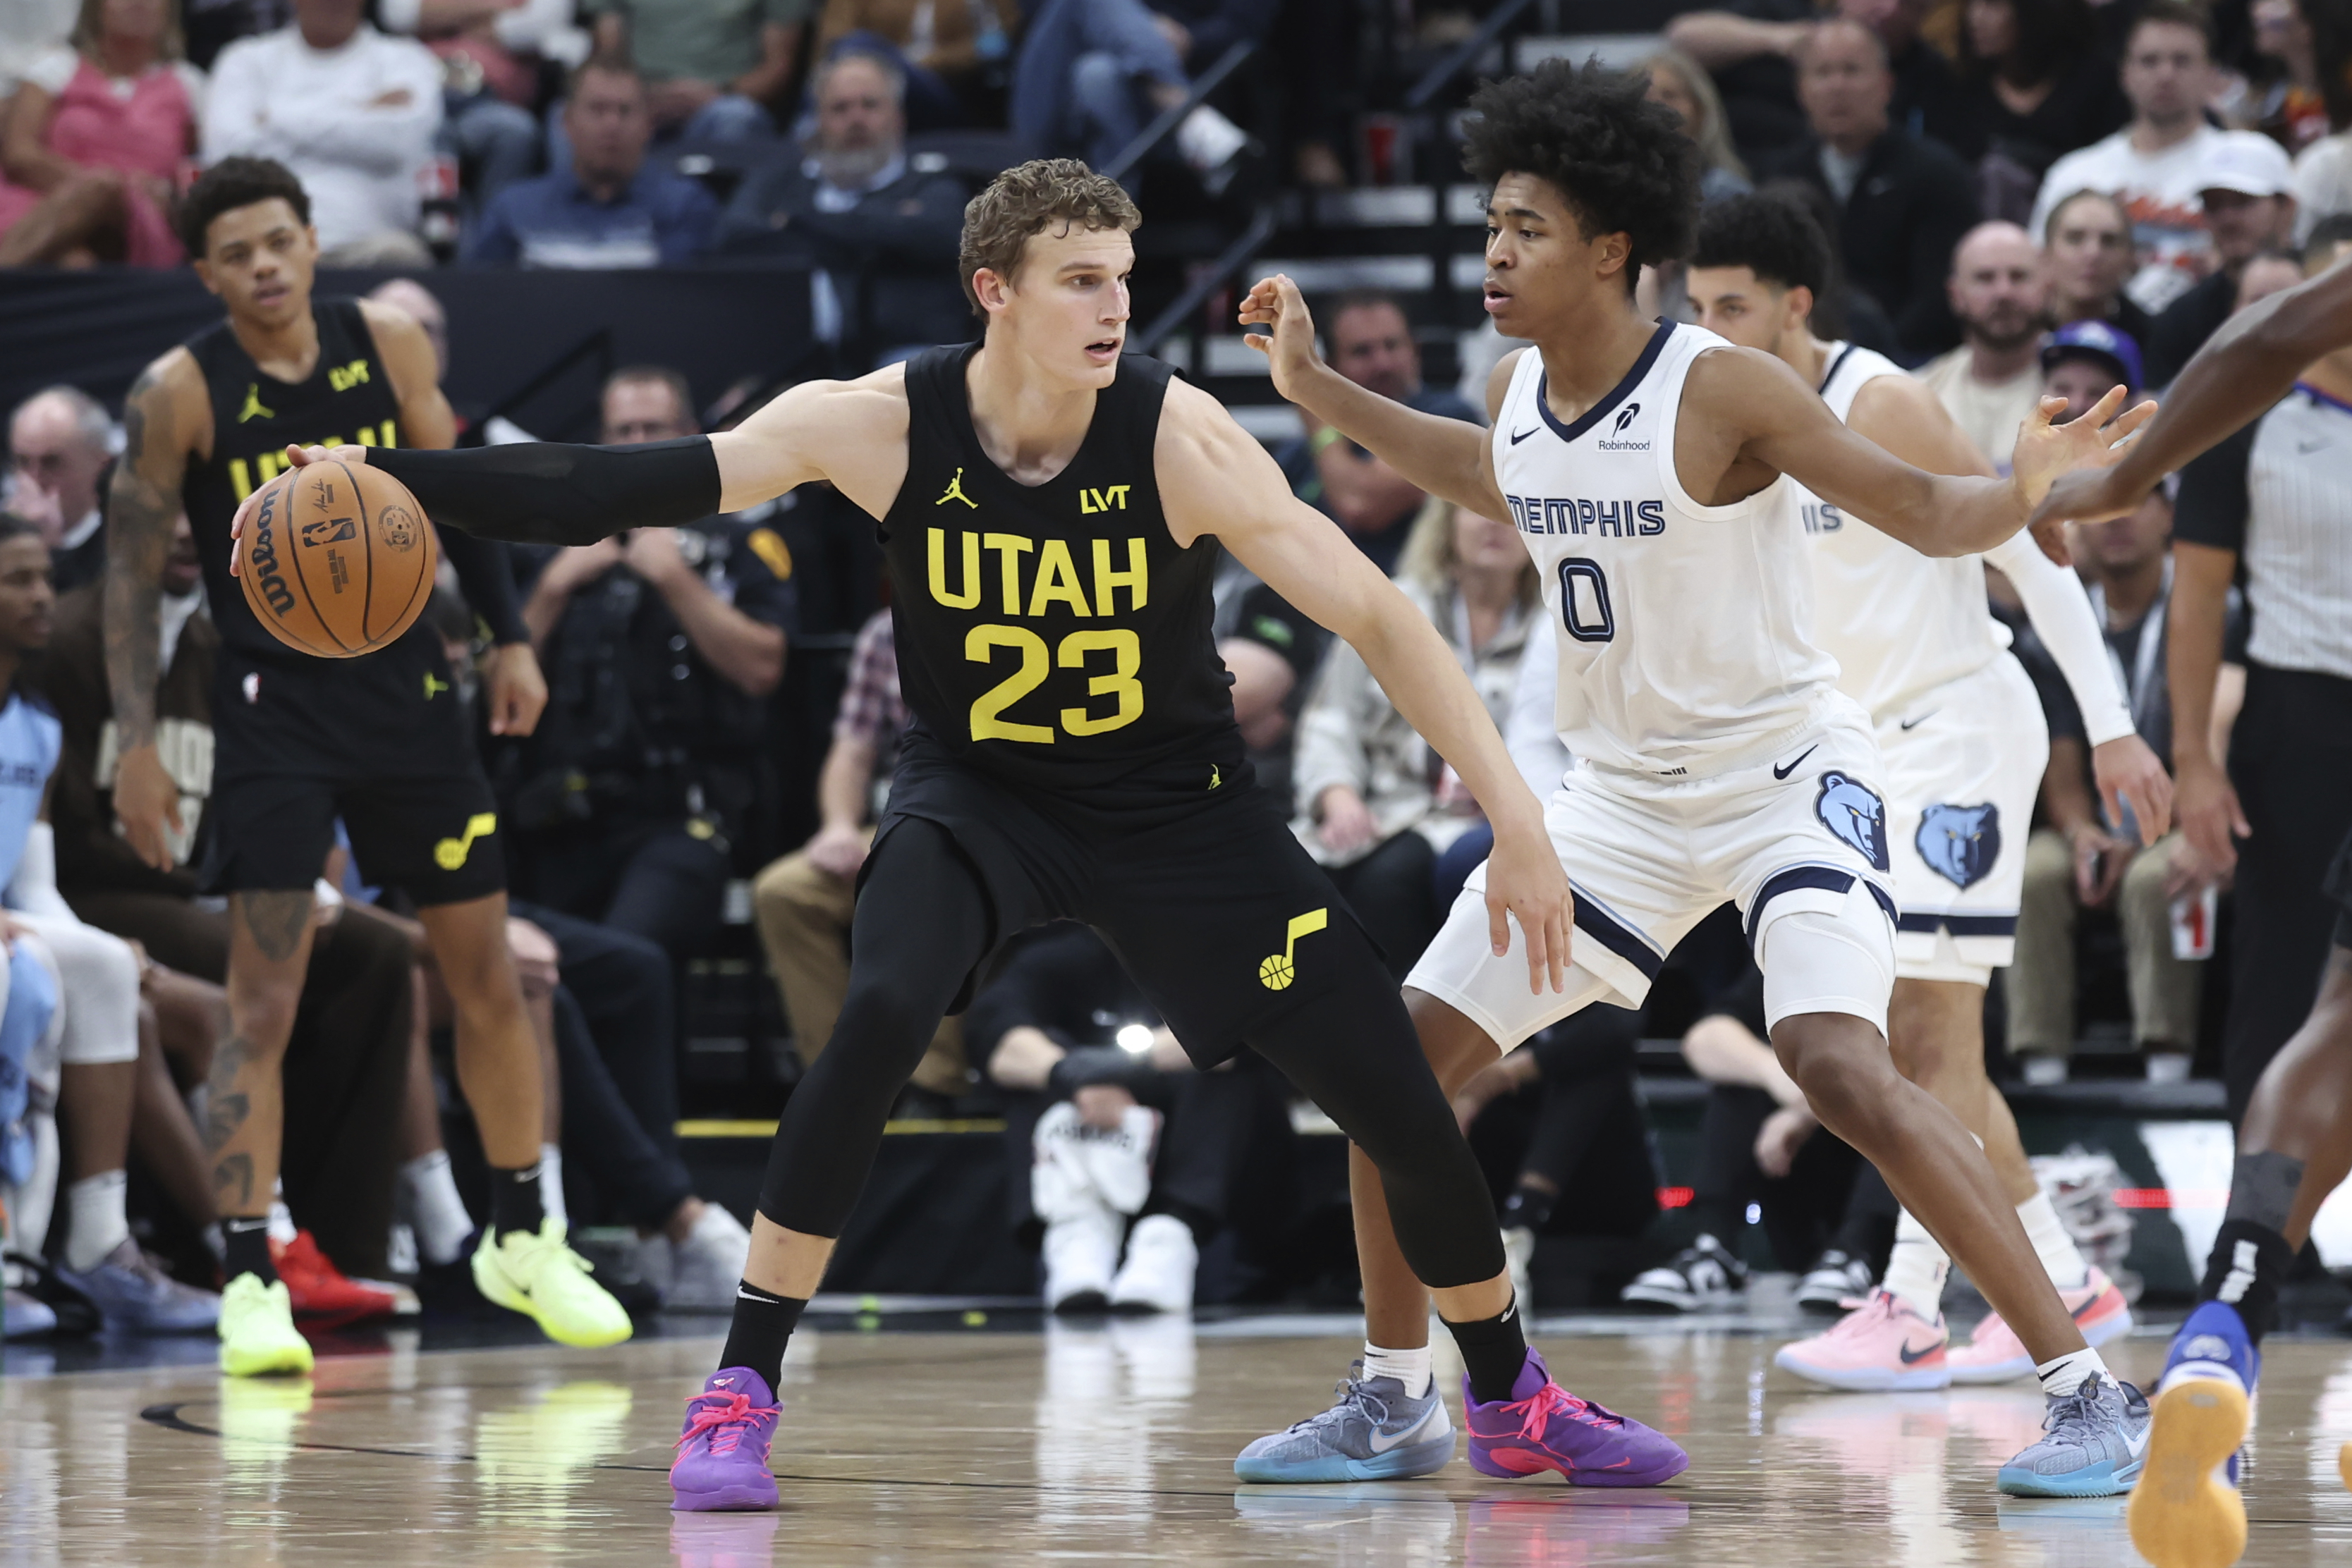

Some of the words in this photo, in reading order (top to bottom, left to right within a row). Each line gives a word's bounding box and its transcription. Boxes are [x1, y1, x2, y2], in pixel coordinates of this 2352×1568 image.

[1599, 440, 1650, 451] Robinhood
[1080, 485, 1131, 514] LVT
[1506, 494, 1666, 537] MEMPHIS
[252, 489, 295, 618] Wilson
[927, 527, 1148, 617] UTAH
[1558, 558, 1615, 643] 0
[965, 624, 1144, 744] 23
